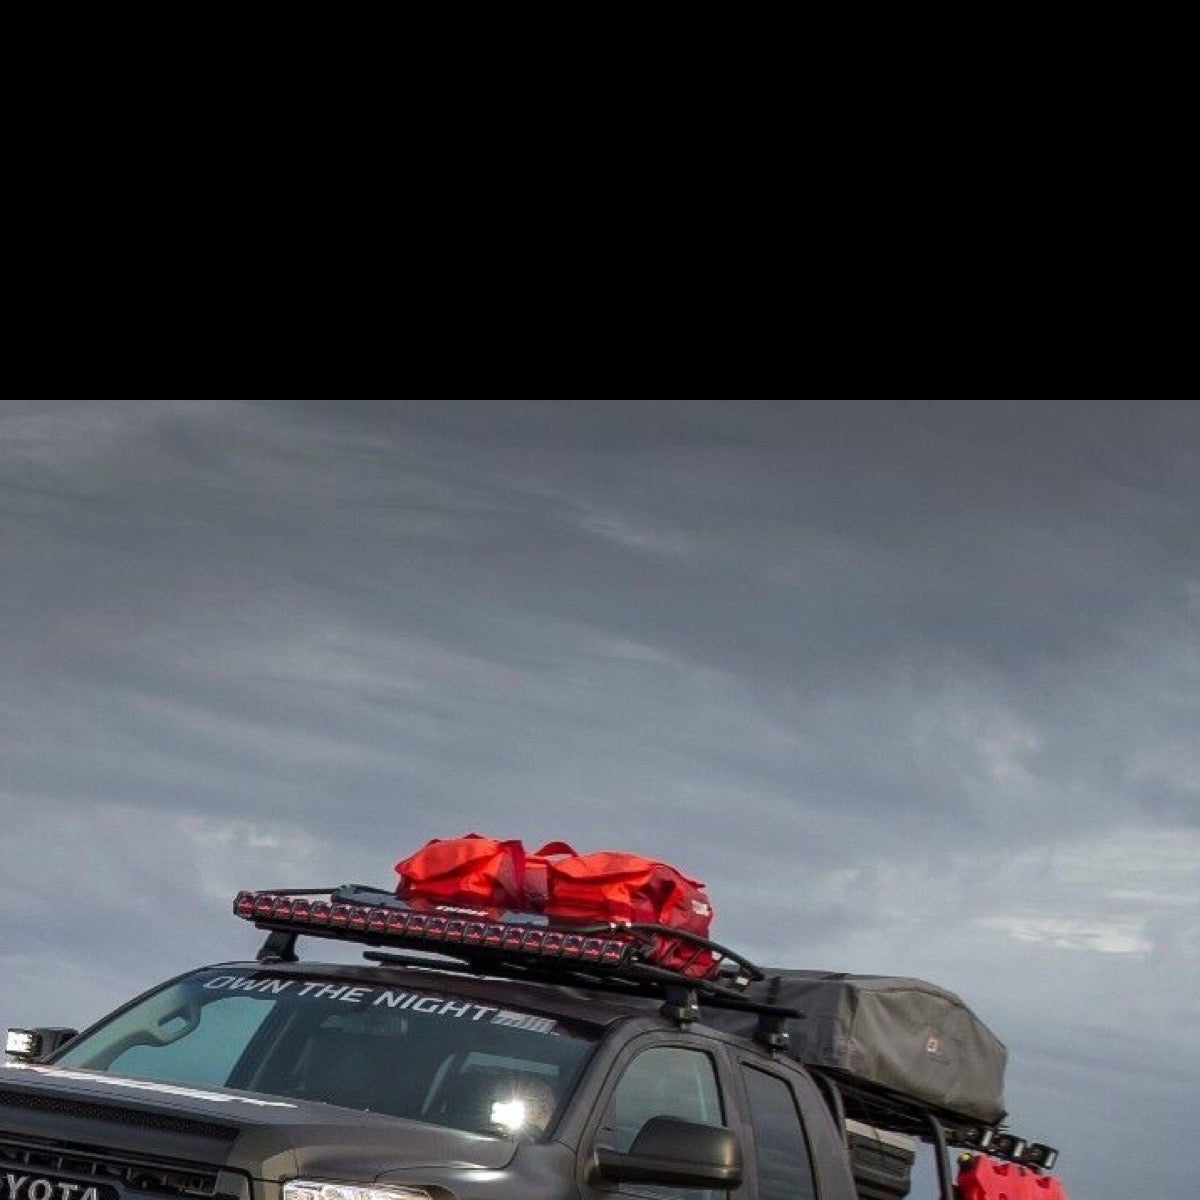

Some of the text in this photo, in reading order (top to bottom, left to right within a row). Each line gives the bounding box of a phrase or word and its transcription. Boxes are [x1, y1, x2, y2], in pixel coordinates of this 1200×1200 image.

[203, 975, 499, 1021] OWN THE NIGHT
